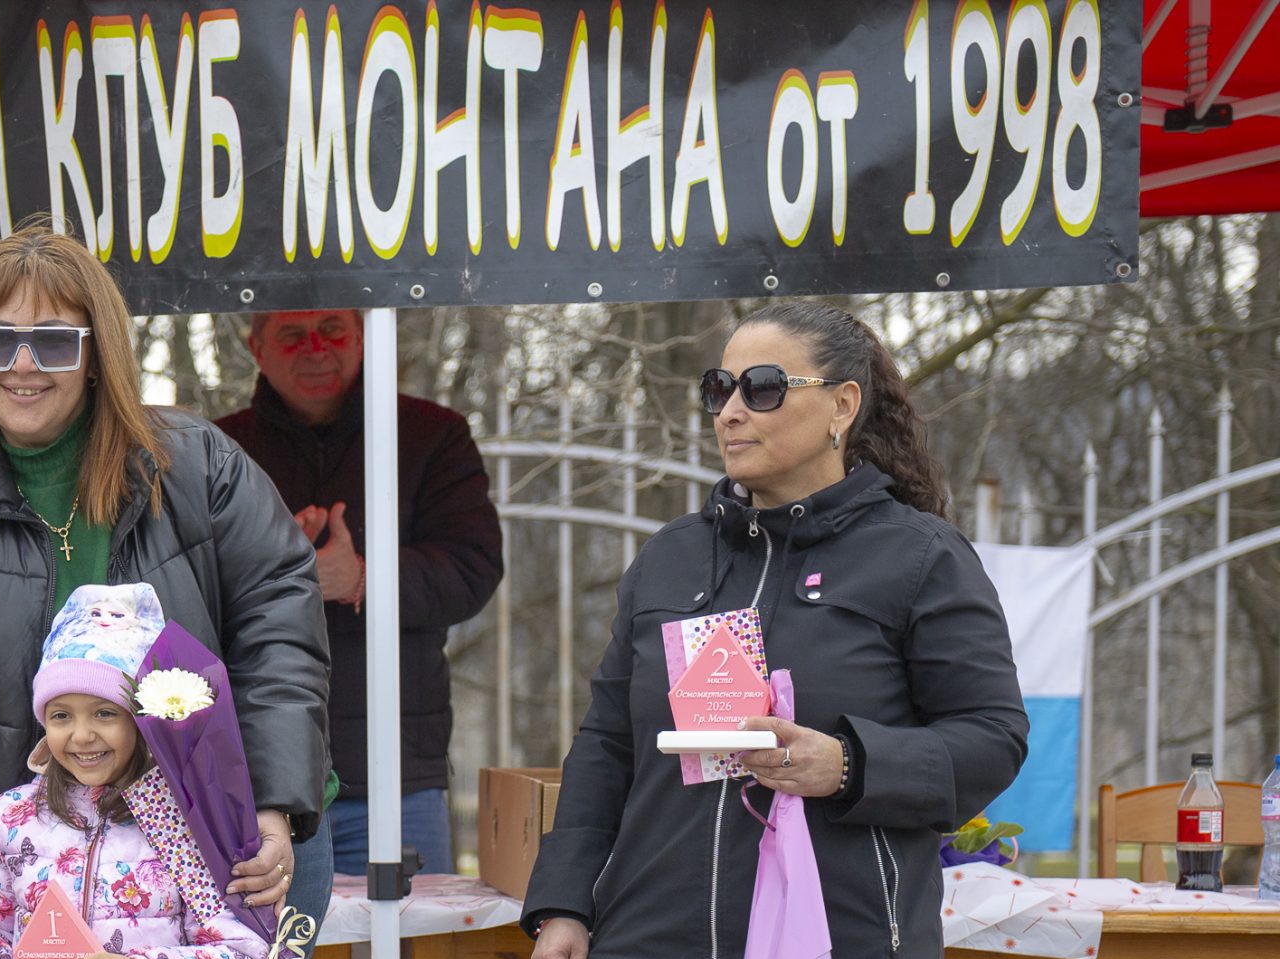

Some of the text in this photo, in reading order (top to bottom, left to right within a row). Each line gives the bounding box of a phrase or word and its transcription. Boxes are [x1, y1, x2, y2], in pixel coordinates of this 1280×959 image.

[37, 8, 243, 264] КЛУБ
[282, 0, 728, 264] МОНТАНА
[903, 0, 1102, 248] 1998
[706, 701, 732, 711] 2026
